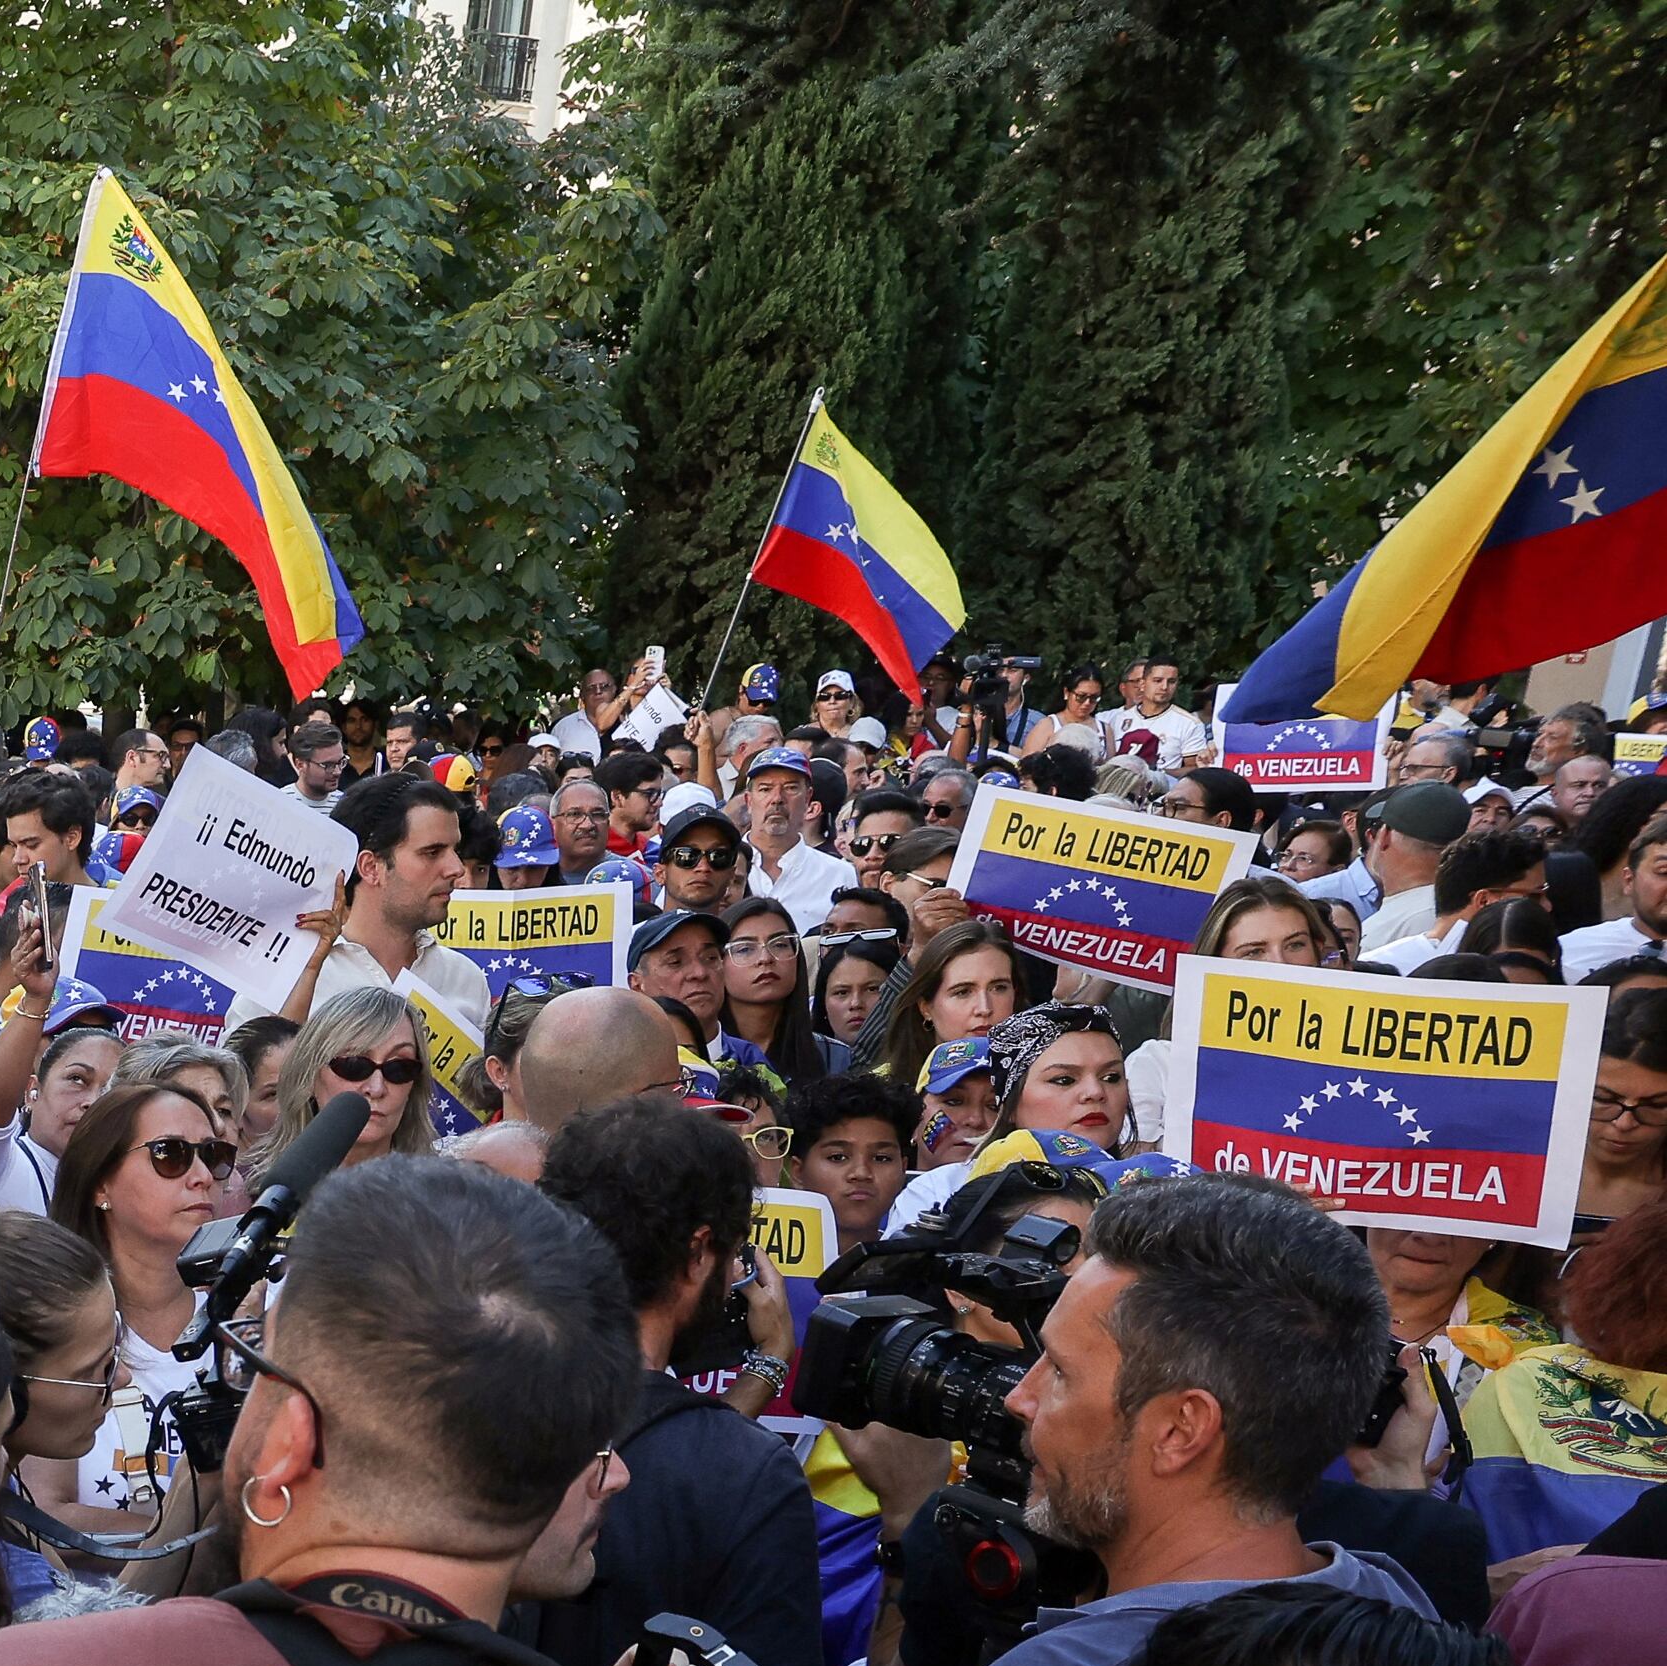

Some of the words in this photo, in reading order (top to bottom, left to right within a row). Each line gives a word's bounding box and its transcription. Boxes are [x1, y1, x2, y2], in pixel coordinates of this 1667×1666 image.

[1257, 757, 1360, 777] VENEZUELA
[223, 818, 316, 889] Edmundo
[1001, 812, 1046, 850] Por
[1052, 822, 1077, 858] la
[1086, 829, 1211, 882] LIBERTAD
[139, 872, 266, 947] PRESIDENTE
[437, 916, 457, 940] or
[469, 911, 485, 941] la
[498, 904, 598, 942] LIBERTAD
[1013, 919, 1166, 973] VENEZUELA
[432, 1036, 455, 1072] la
[1226, 990, 1281, 1043] Por
[1296, 999, 1323, 1050] la
[1341, 1005, 1533, 1067] LIBERTAD
[1214, 1142, 1250, 1174] de
[1261, 1147, 1507, 1205] VENEZUELA
